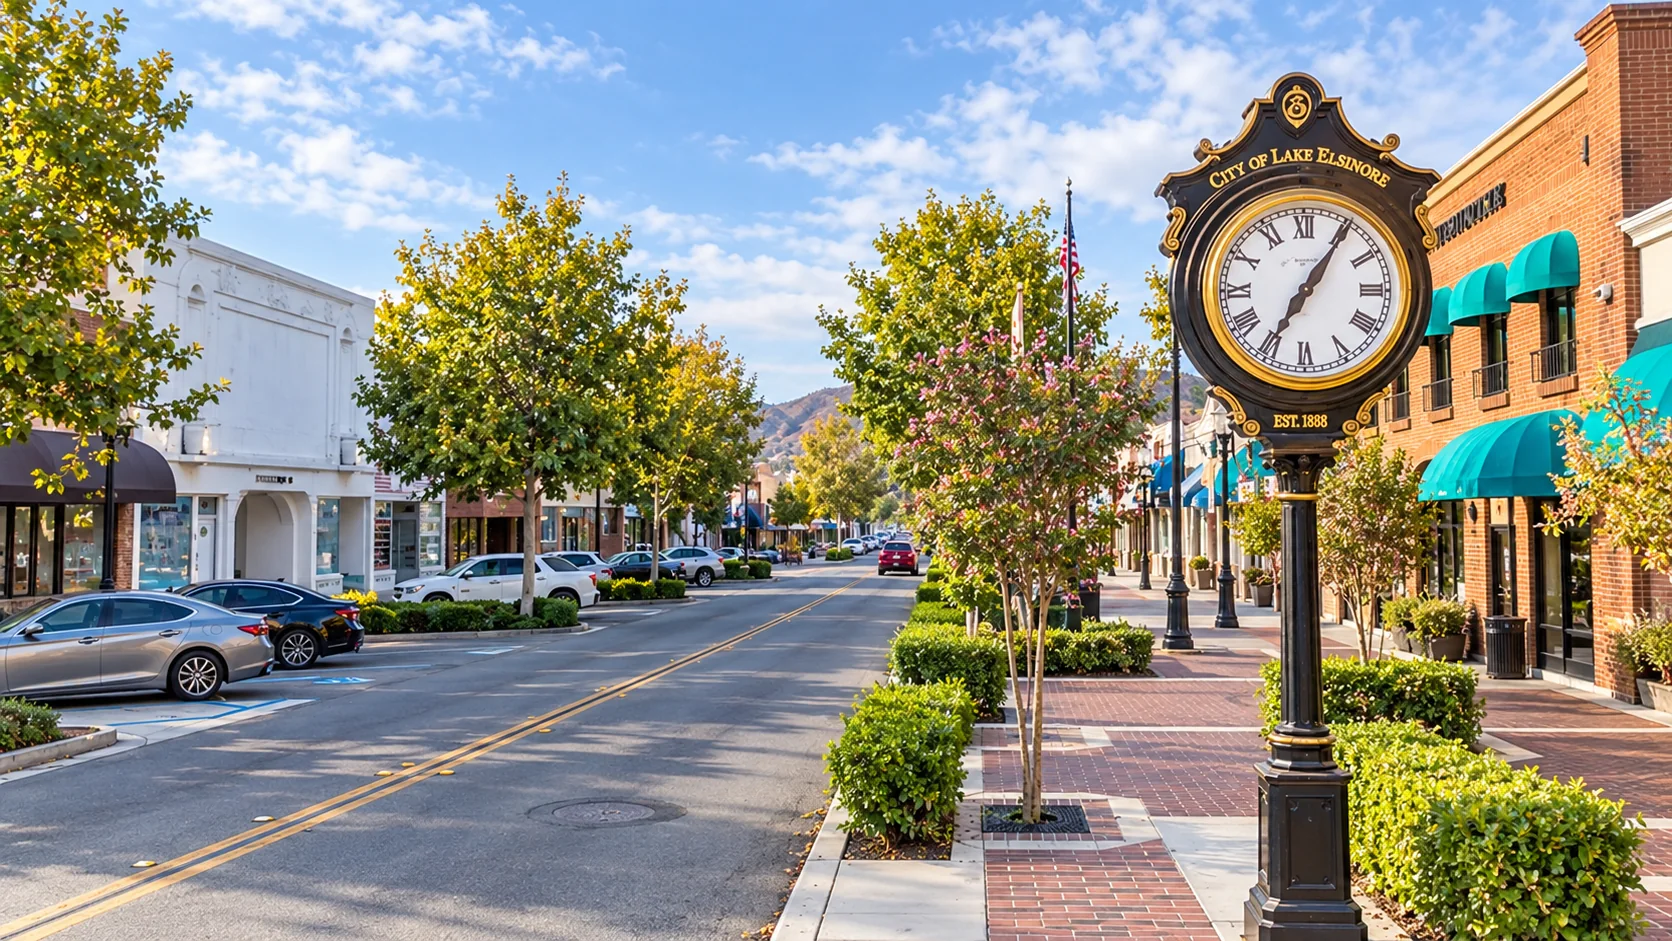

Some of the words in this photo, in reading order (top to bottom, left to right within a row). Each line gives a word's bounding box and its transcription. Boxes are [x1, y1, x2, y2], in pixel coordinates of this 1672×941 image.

[1209, 161, 1246, 188] CITY
[1270, 148, 1313, 165] LAKE
[1316, 147, 1391, 188] ELSINORE
[1258, 222, 1285, 250] XI
[1293, 215, 1315, 239] XII
[1234, 249, 1261, 271] X
[1350, 249, 1375, 269] II
[1359, 283, 1383, 297] III
[1297, 341, 1314, 366] VI
[1331, 335, 1350, 358] V
[1273, 414, 1300, 428] EST.
[1301, 414, 1328, 428] 1888
